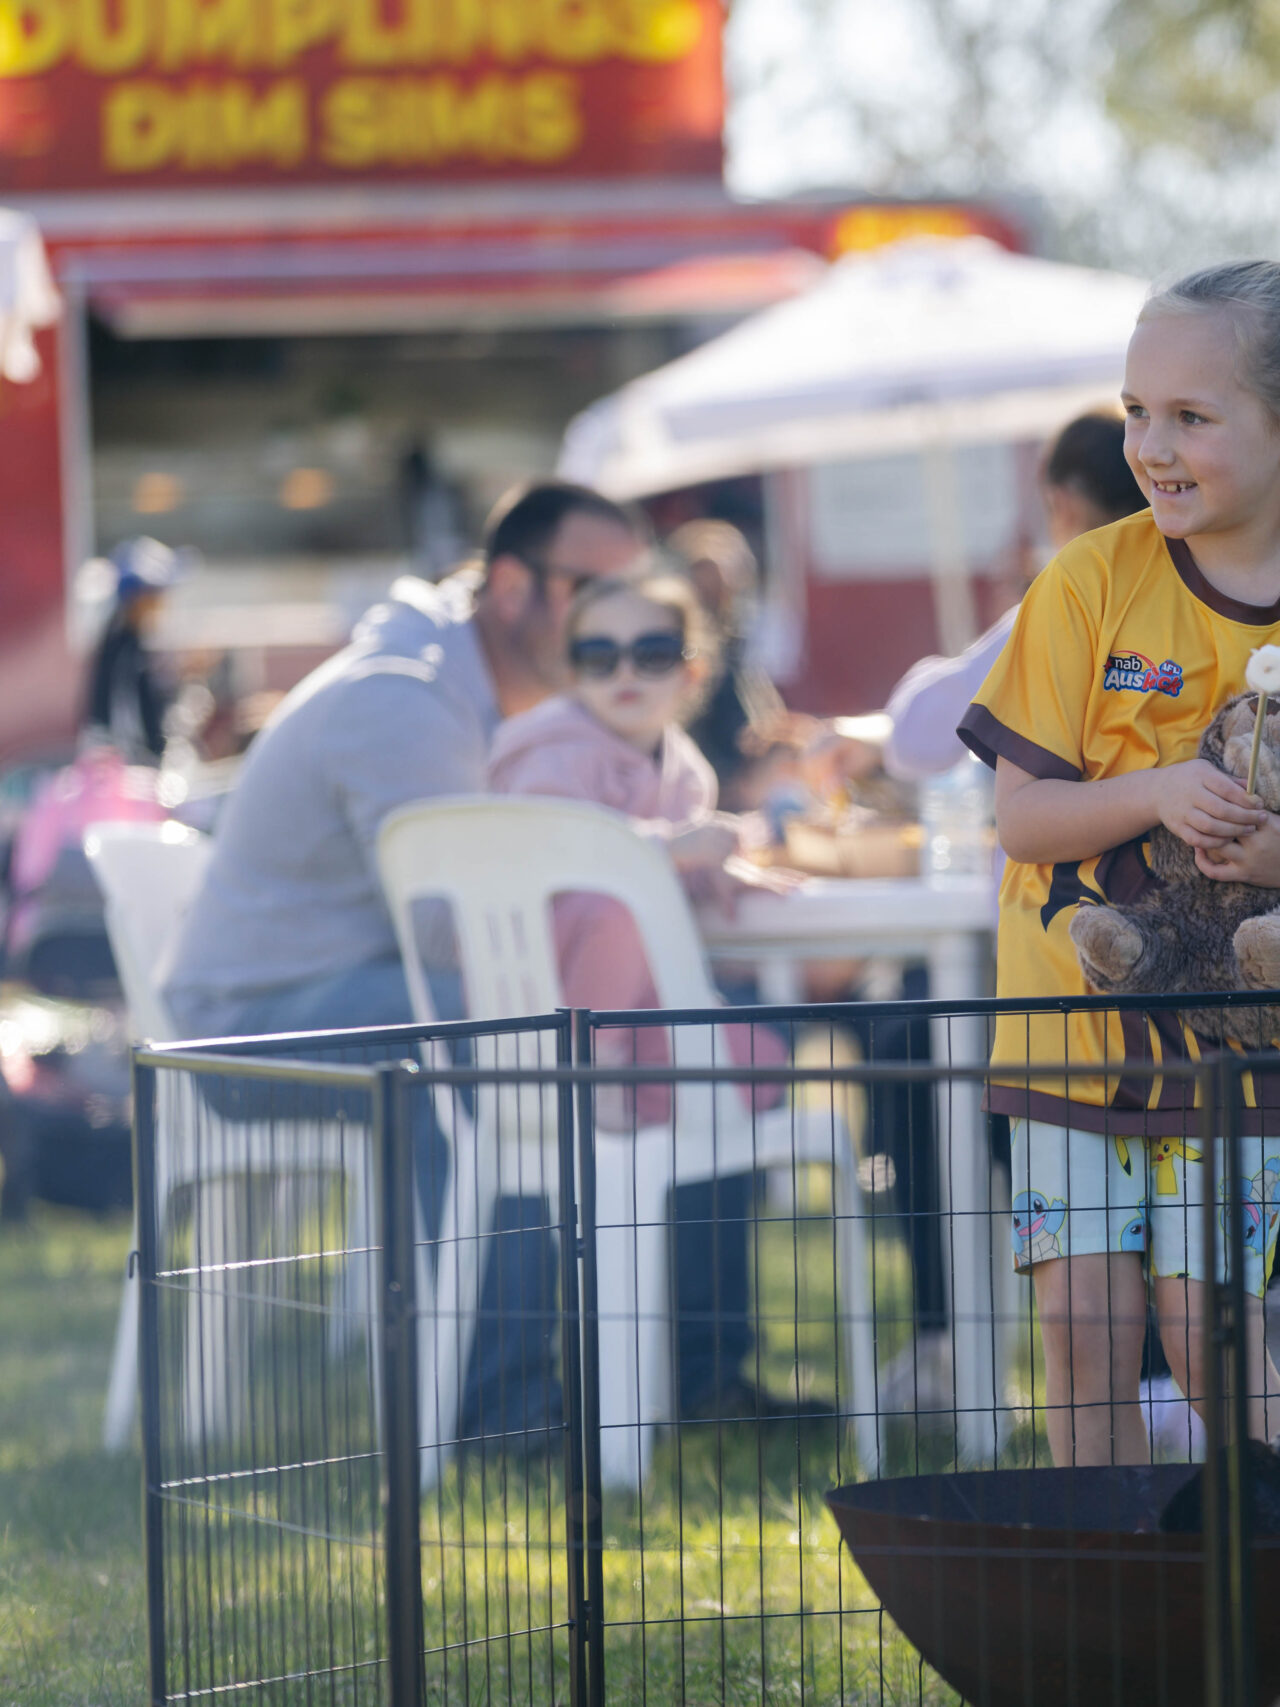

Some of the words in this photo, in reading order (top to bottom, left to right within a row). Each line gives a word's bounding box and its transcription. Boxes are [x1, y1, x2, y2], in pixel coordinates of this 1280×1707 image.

[0, 0, 697, 76] DUMPLINGS
[104, 80, 308, 172] DIM
[322, 73, 580, 166] SIMS
[1115, 658, 1141, 671] nab
[1161, 662, 1180, 676] AFL
